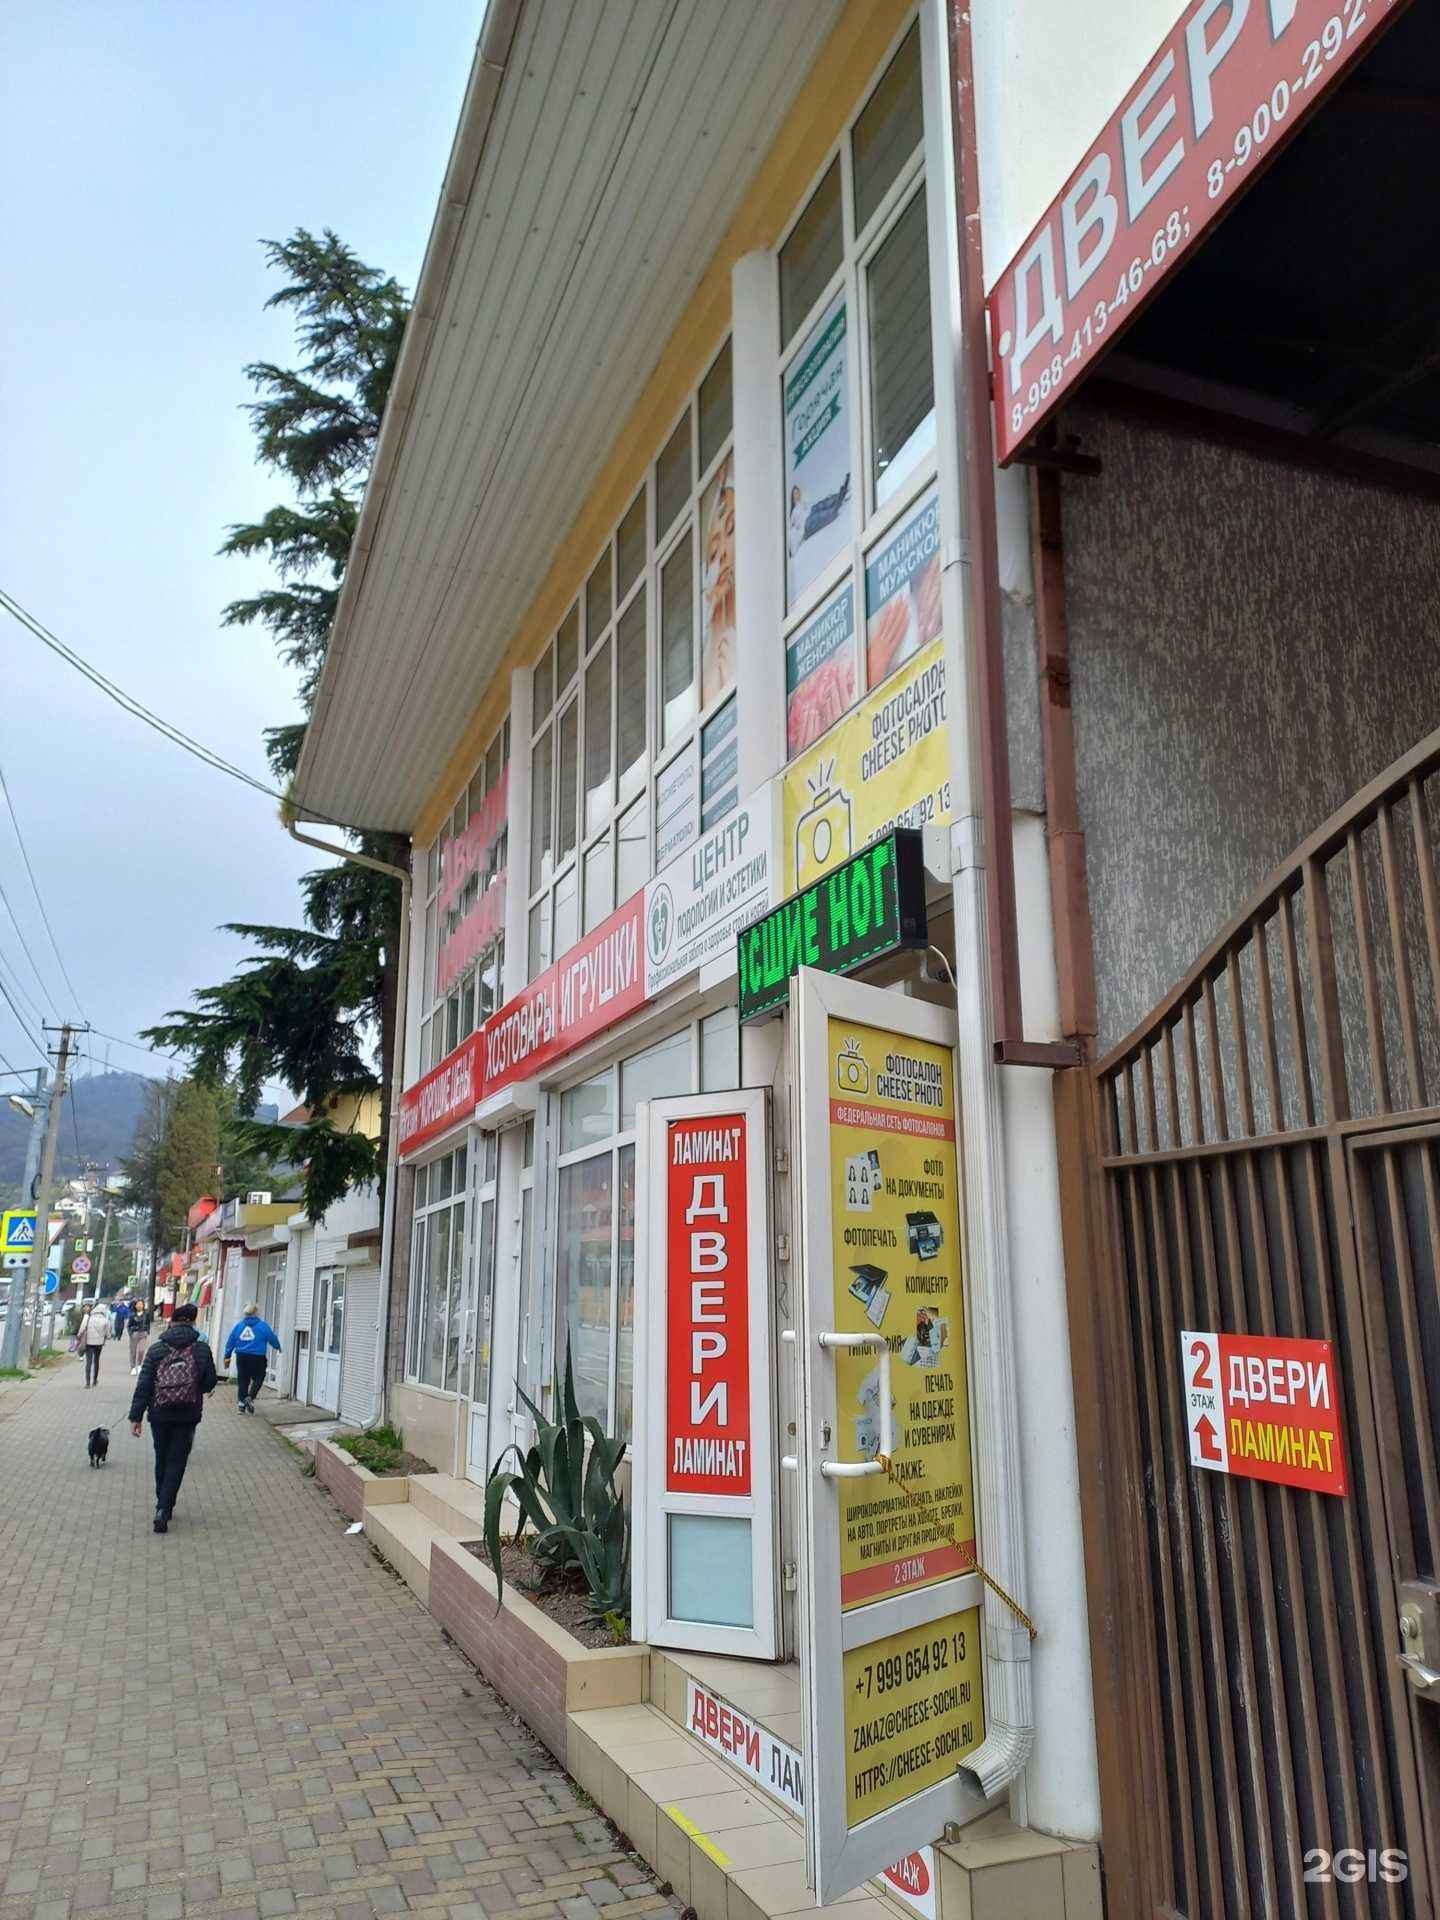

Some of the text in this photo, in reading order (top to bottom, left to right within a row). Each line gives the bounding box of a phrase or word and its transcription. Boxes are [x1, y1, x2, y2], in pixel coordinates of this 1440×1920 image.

[1011, 0, 1373, 433] 8-988-413-46-68; 8-900-292
[878, 504, 938, 580] МАНИКЮ
[797, 598, 848, 658] МАНИКЮР
[798, 619, 848, 677] ЖЕНСКИЙ
[862, 724, 905, 782] CHEESE
[692, 812, 749, 892] ЦЕНТР
[677, 894, 718, 938] ПОДОЛОГИИ
[726, 850, 767, 907] ЭСТЕТИКИ
[829, 844, 890, 951] НОГ
[486, 981, 555, 1081] ХОЗТОВАРЫ
[561, 914, 638, 1031] ИГРУШКИ
[885, 1053, 943, 1085] ФОТОСАЛОН
[876, 1074, 943, 1107] CHEESE PHOTO
[837, 1106, 945, 1137] ФЕДЕРАЛЬНАЯ СЕТЬ ФОТОСАЛОНОВ
[673, 1128, 741, 1165] ЛАМИНАТ
[923, 1158, 944, 1176] ФОТО
[886, 1177, 944, 1199] НА ДОКУМЕНТЫ
[844, 1227, 897, 1247] ФОТОПЕЧАТЬ
[685, 1174, 728, 1426] ДВЕРИ
[905, 1275, 949, 1295] КОПИЦЕНТР
[925, 1373, 953, 1393] ПЕЧАТЬ
[1190, 1340, 1213, 1389] 2
[1228, 1355, 1331, 1410] ДВЕРИ
[910, 1398, 954, 1421] НА ОДЕЖДЕ
[1191, 1393, 1215, 1410] ЭТАЖ
[905, 1422, 956, 1449] И СУВЕНИРАХ
[1230, 1418, 1334, 1473] ЛАМИНАТ
[673, 1437, 745, 1477] ЛАМИНАТ
[895, 1459, 926, 1482] ТАКЖЕ:
[846, 1496, 909, 1522] ШИРОКОФОРМАТНАЯ
[934, 1482, 964, 1501] НАКЛЕЙКИ
[848, 1526, 856, 1542] НА
[876, 1516, 907, 1535] ПОРТРЕТЫ
[908, 1513, 916, 1527] НА
[860, 1539, 892, 1560] МАГНИТЫ
[897, 1531, 920, 1553] ДРУГАЯ
[894, 1557, 925, 1584] 2 ЭТАЖ
[856, 1631, 966, 1699] +7 999 654 92 13
[692, 1687, 760, 1773] ДВЕРИ
[854, 1680, 971, 1753] ZAKAZ@CHEESE-SOCHI.RU
[855, 1721, 973, 1799] HTTPS://CHEESE-SOCHI.RU
